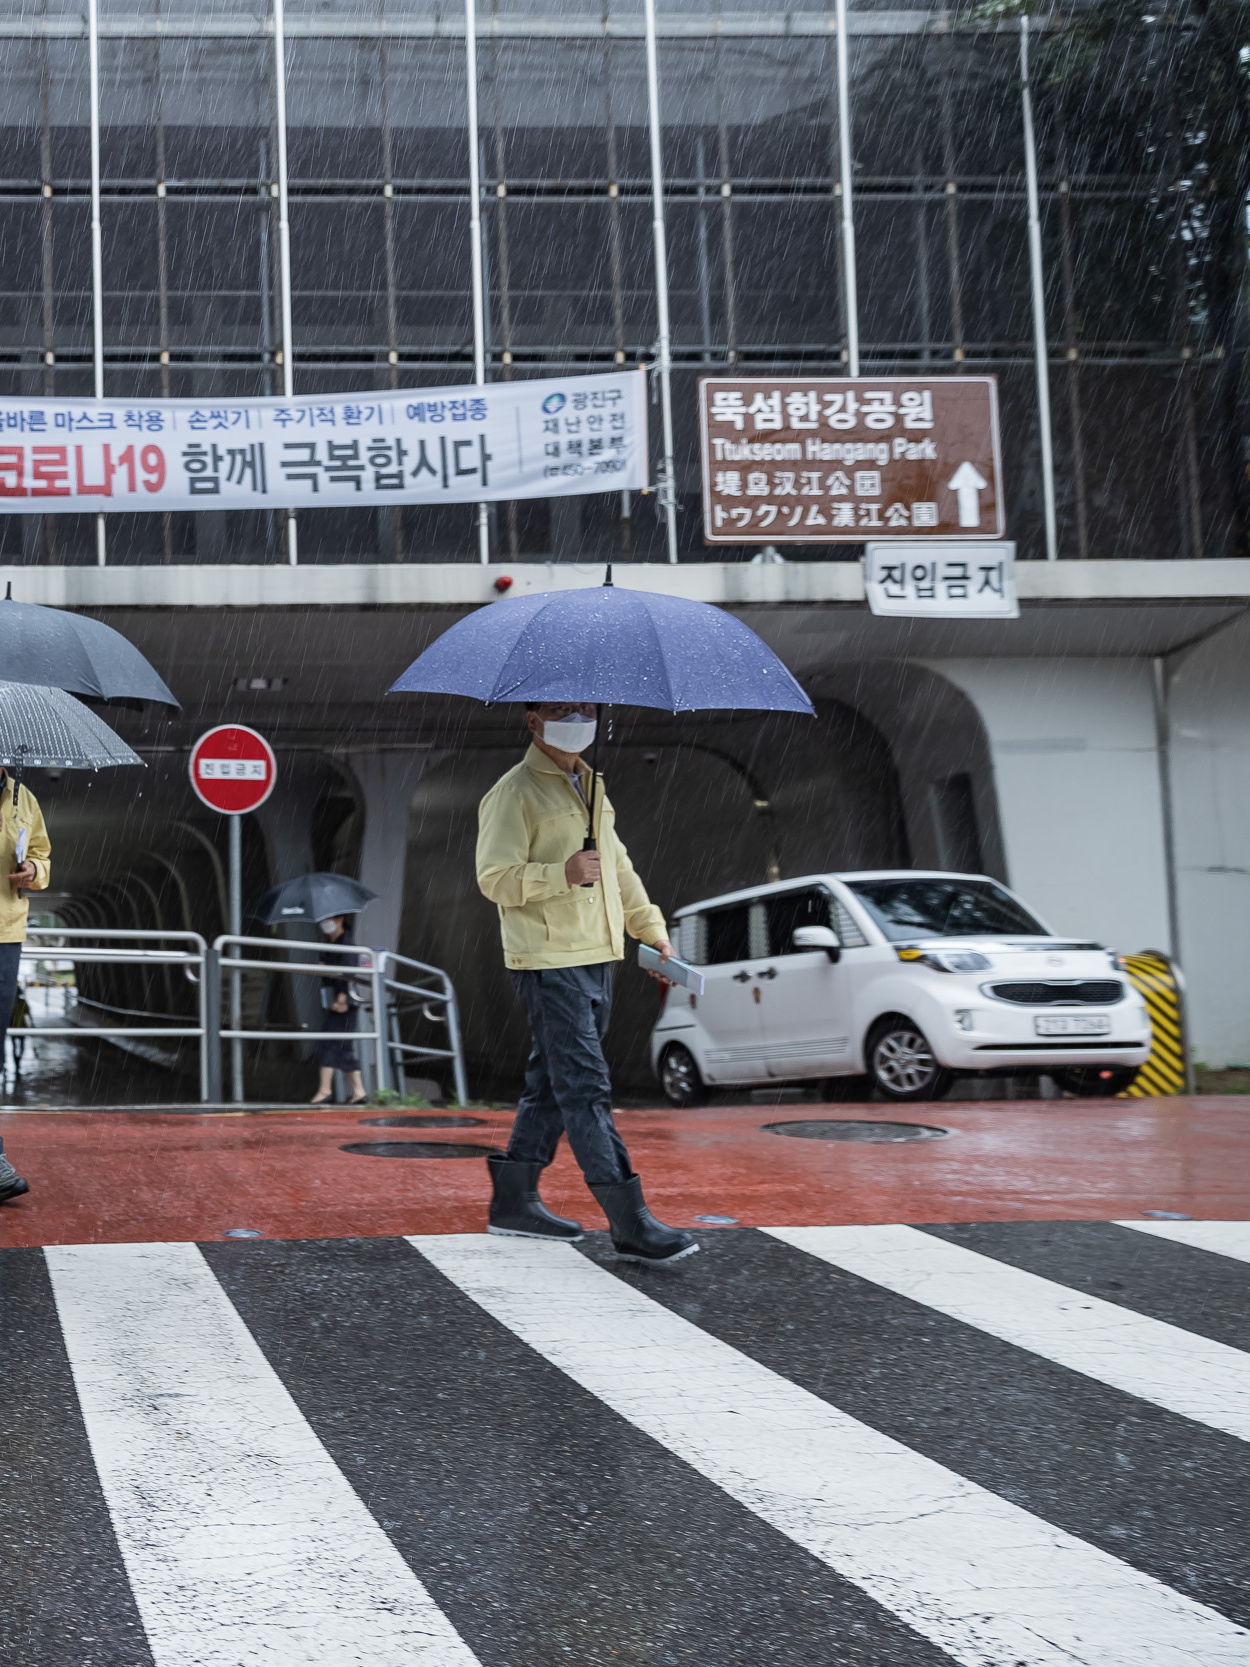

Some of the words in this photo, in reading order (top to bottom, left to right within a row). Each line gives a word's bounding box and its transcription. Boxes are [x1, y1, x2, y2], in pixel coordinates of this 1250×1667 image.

[54, 411, 117, 432] 마스크
[124, 410, 165, 432] 착용
[188, 408, 250, 430] 손씻기
[273, 405, 335, 428] 주기적
[342, 404, 383, 426] 환기
[406, 398, 487, 423] 예방접종
[572, 389, 623, 410] 광진구
[710, 390, 934, 431] 뚝섬한강공원
[181, 441, 268, 495] 함께
[280, 434, 492, 493] 극복합시다
[711, 437, 802, 461] Ttukseom
[805, 437, 890, 466] Hangang
[892, 437, 937, 461] Park
[877, 561, 1006, 600] 진입금지
[205, 763, 262, 776] 진입금지
